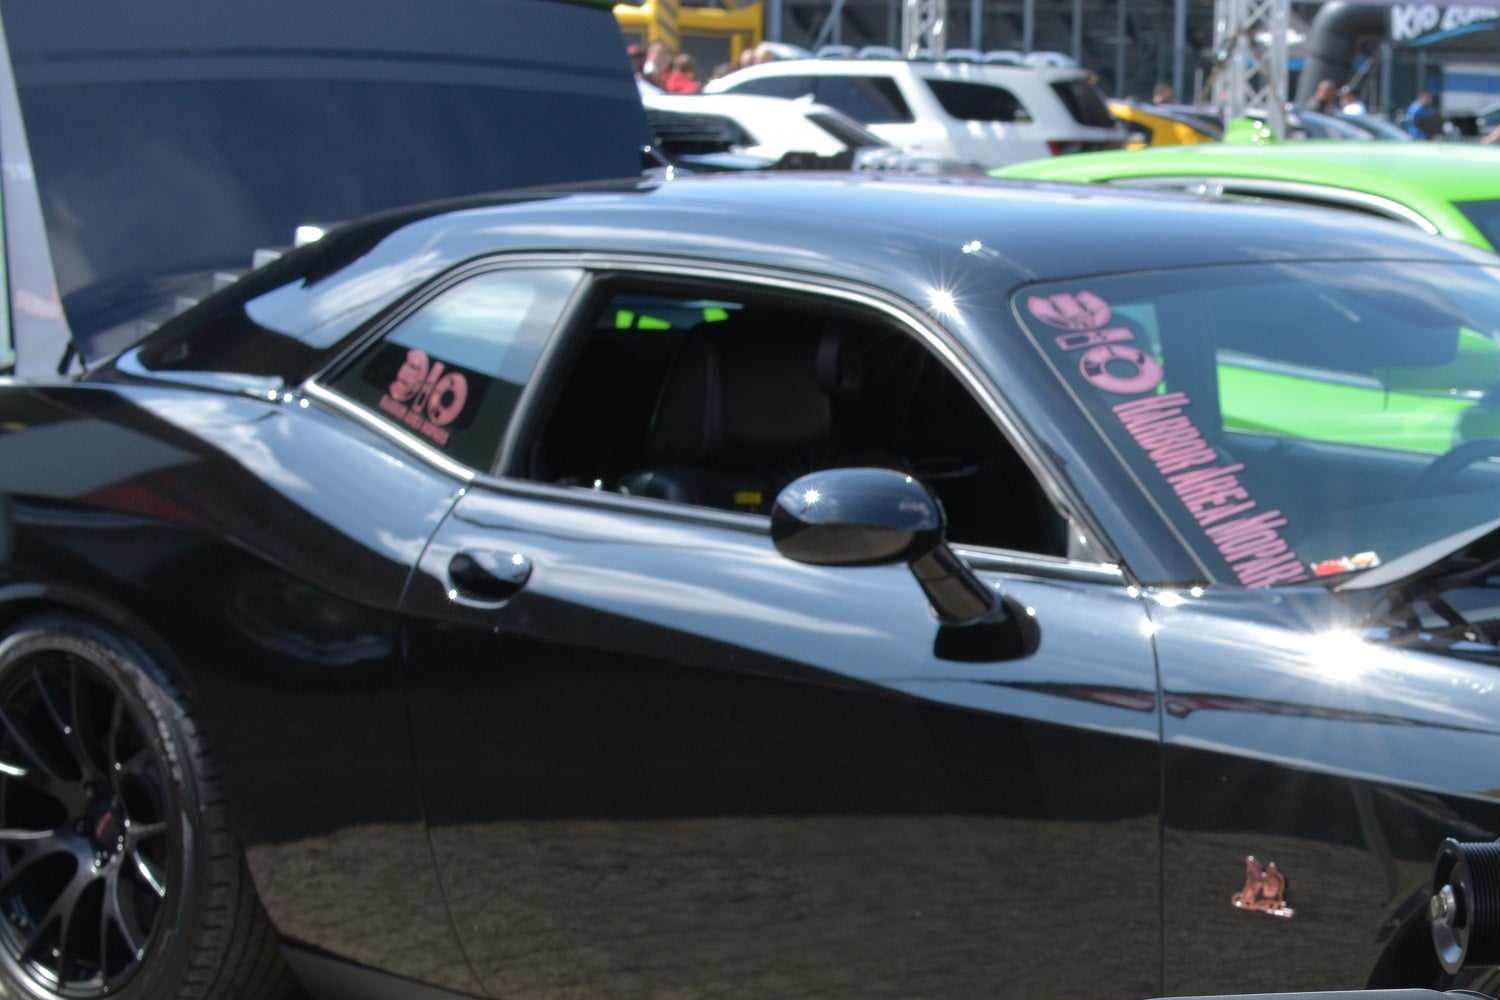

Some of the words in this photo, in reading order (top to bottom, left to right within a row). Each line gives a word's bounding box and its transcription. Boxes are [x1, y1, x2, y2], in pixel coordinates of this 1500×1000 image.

[1112, 391, 1222, 476] HARBOR
[1167, 462, 1258, 528] AREA
[1204, 509, 1310, 590] MOPAR
